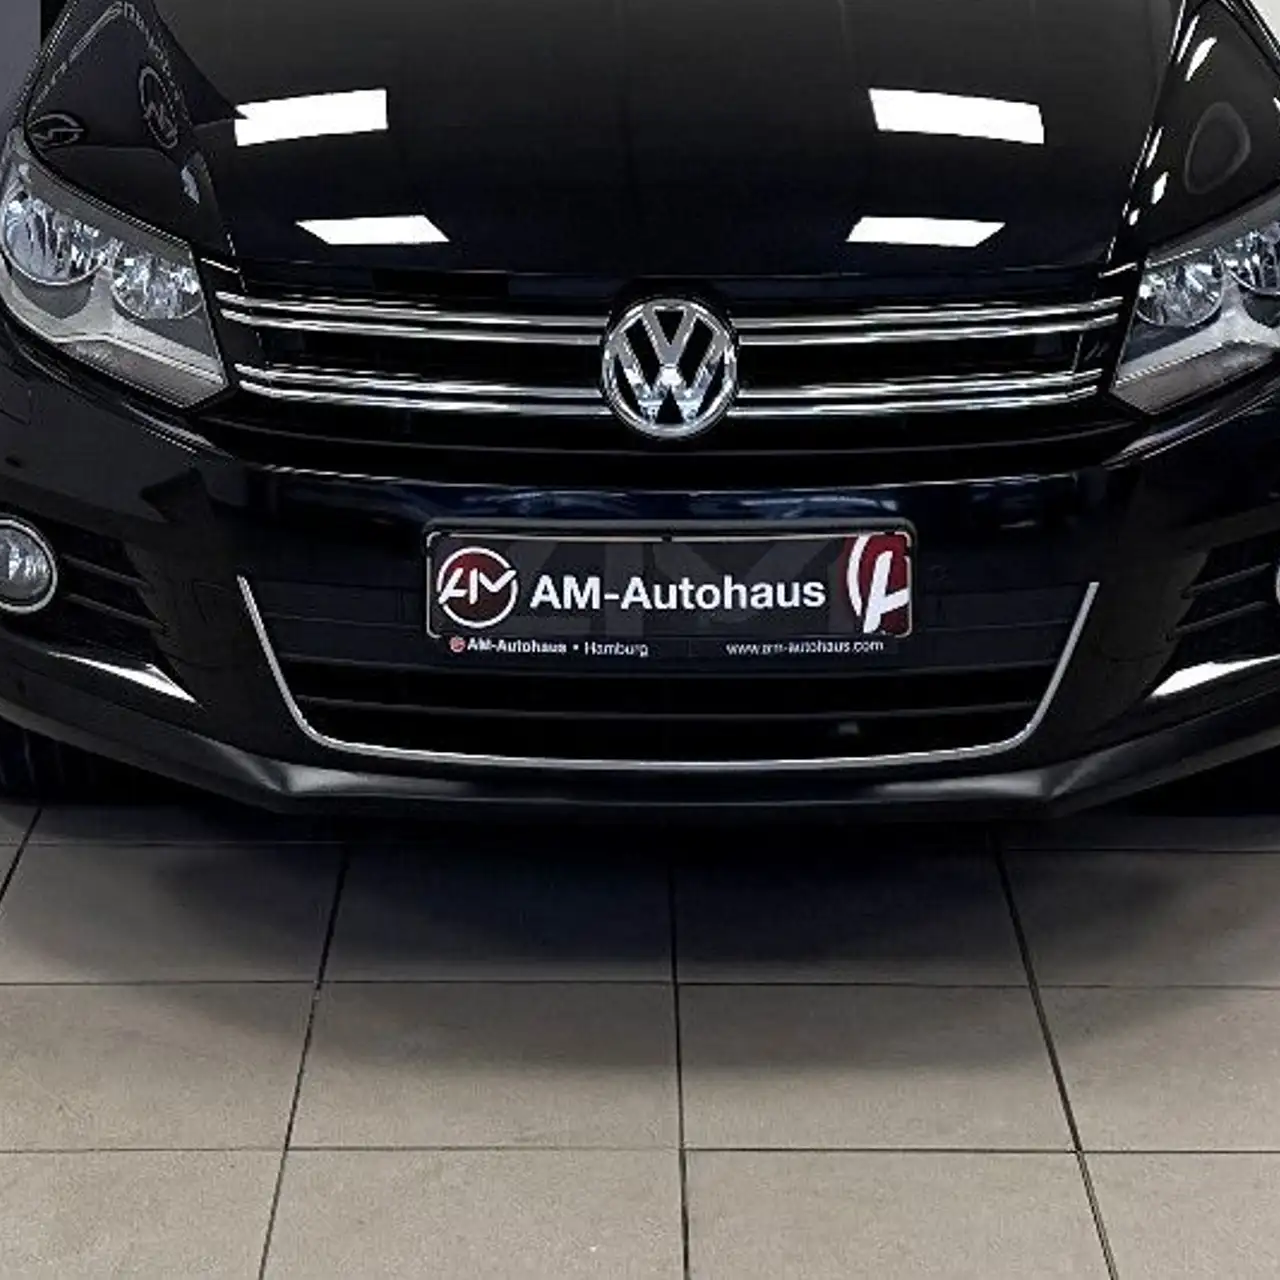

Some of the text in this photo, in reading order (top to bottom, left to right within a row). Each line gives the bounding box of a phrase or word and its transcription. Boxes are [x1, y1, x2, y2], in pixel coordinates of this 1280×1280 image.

[530, 574, 826, 611] AM-Autohaus
[466, 637, 650, 658] AM-Autohaus Hamburg
